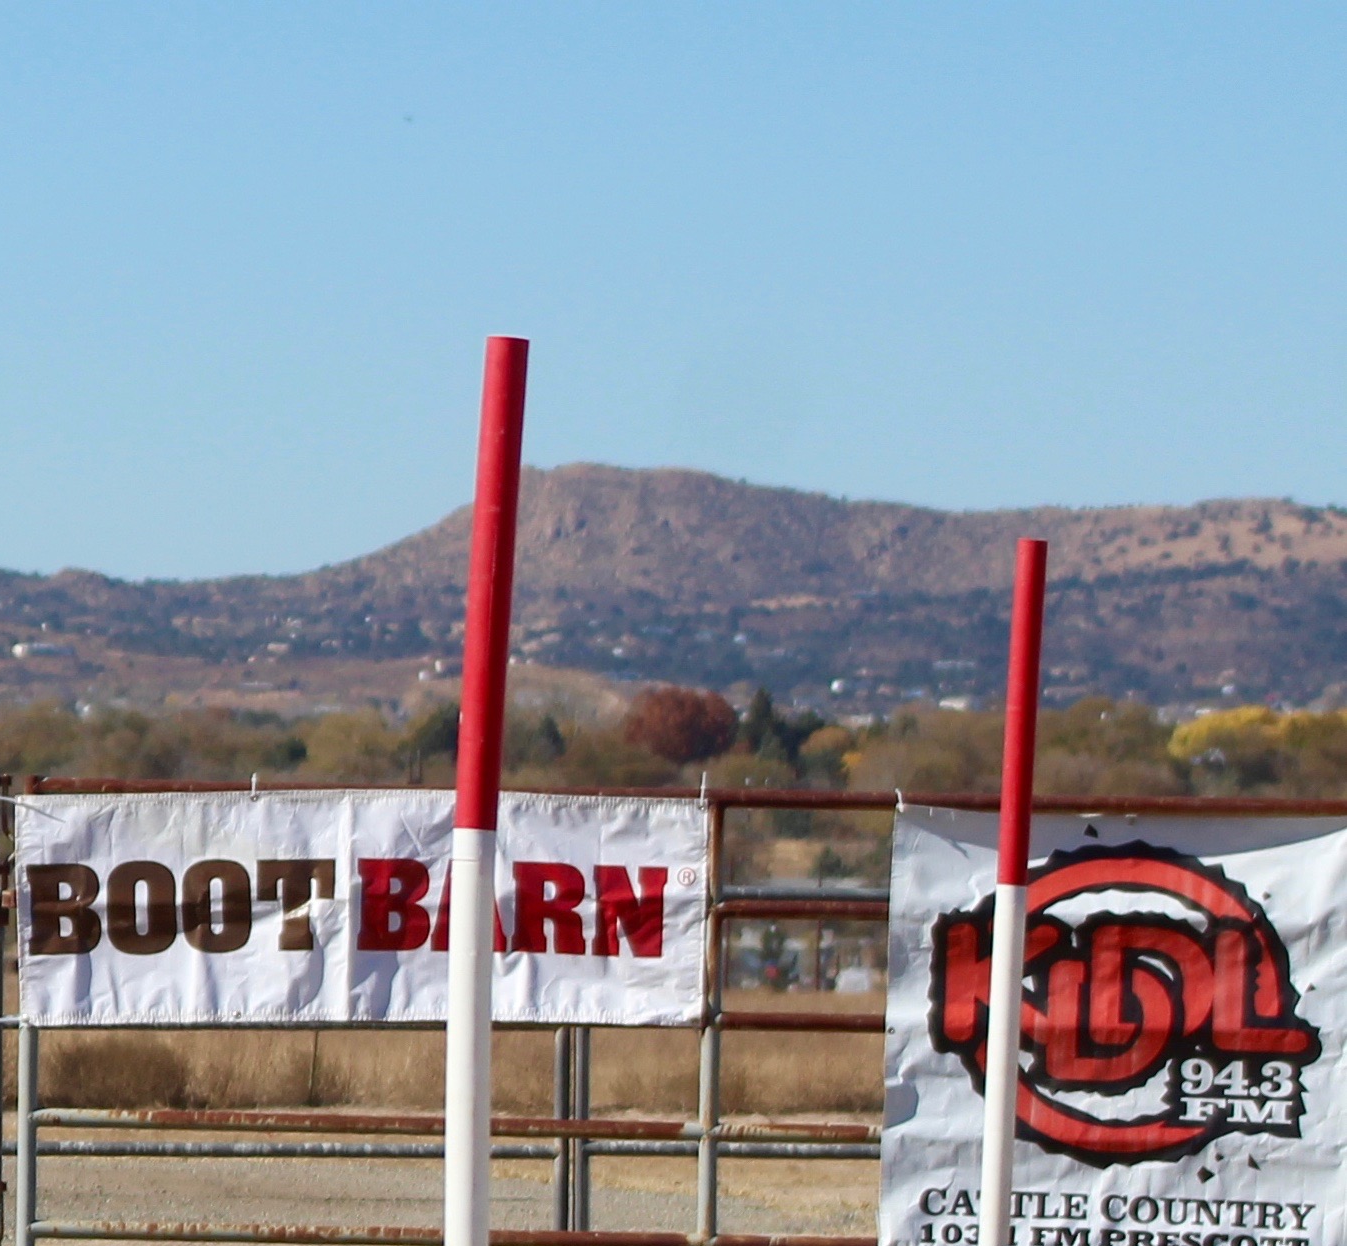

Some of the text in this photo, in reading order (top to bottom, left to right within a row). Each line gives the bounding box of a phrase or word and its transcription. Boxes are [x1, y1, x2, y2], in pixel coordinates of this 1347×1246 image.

[27, 859, 335, 956] BOOT
[1180, 1057, 1294, 1098] 94.3
[1178, 1096, 1293, 1125] FM
[918, 1188, 1316, 1231] CATLE COUNTRY
